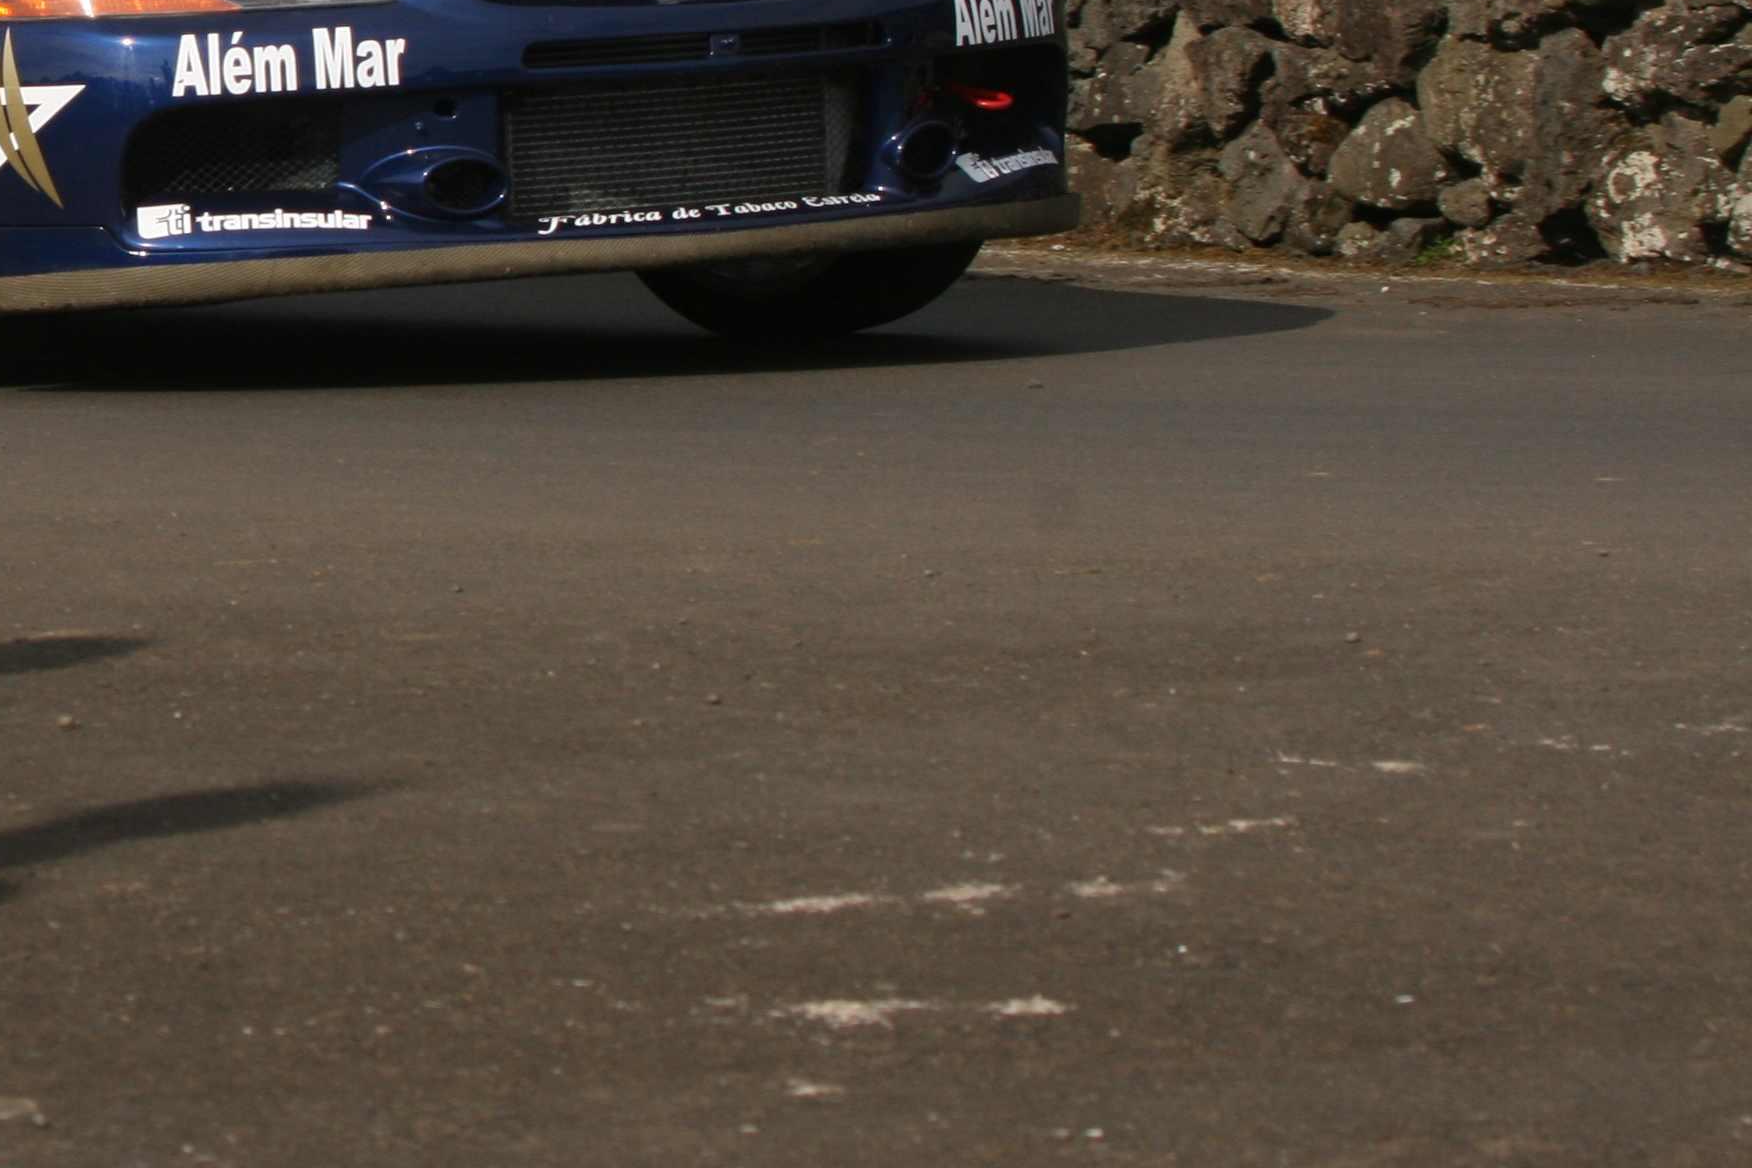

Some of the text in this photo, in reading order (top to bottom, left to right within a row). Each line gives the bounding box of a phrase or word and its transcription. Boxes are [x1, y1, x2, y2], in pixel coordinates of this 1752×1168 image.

[172, 26, 405, 97] Além Mar
[196, 208, 372, 232] transinsular
[538, 192, 881, 235] Fábrica de Tabaco Estrela
